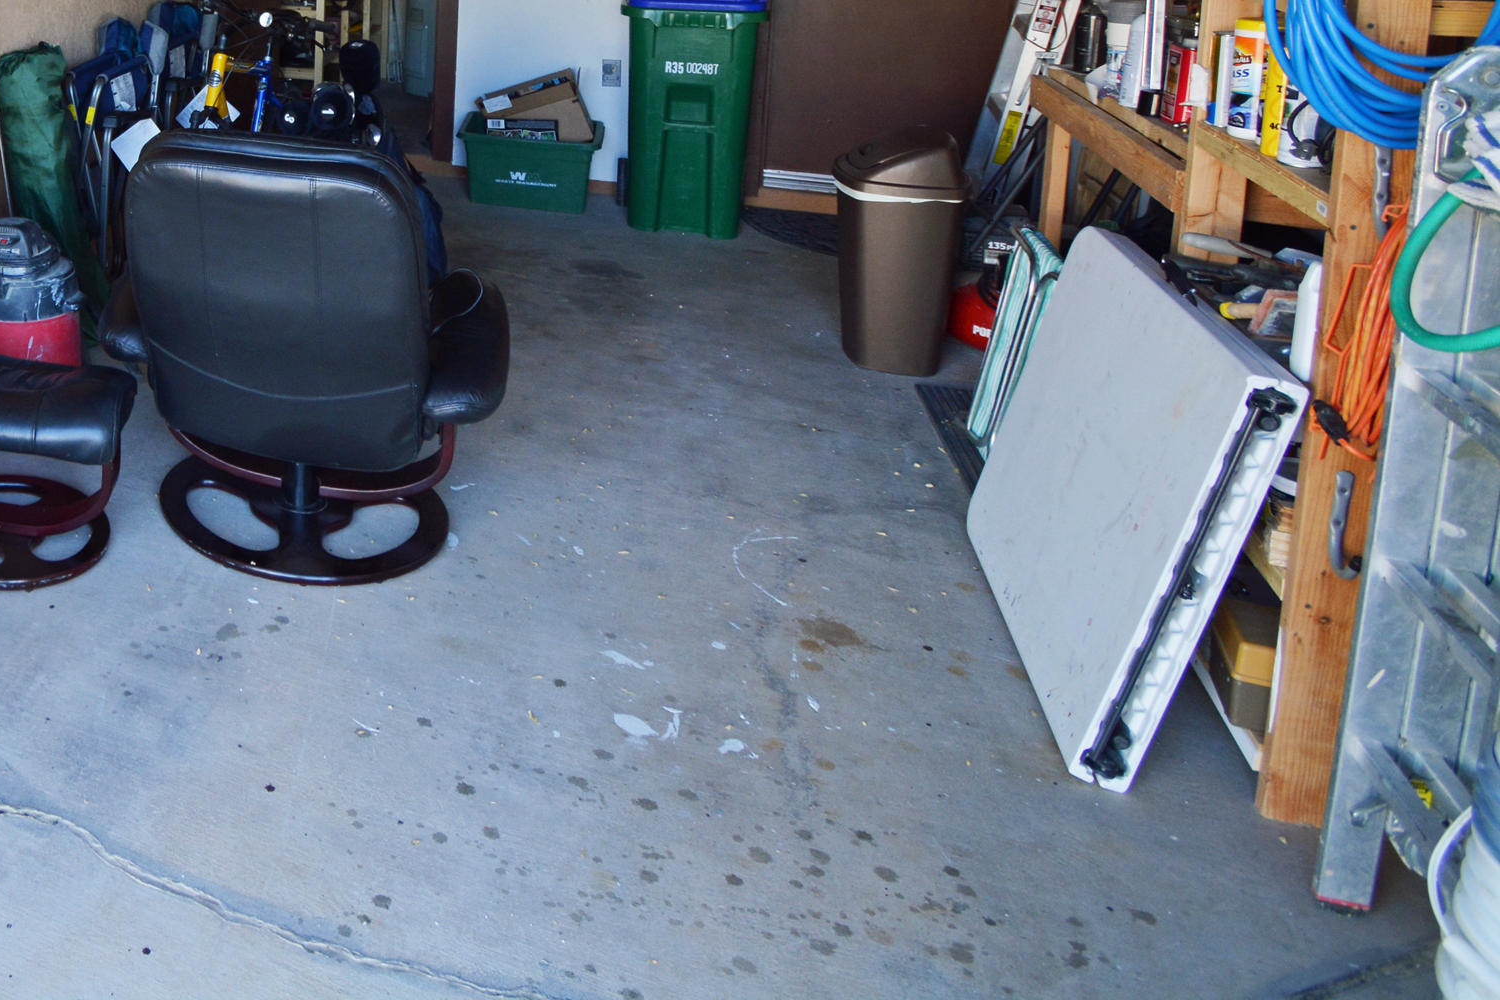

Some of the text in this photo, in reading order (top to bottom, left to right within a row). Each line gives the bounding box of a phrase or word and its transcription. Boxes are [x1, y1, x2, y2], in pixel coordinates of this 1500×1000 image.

[665, 60, 720, 75] R35 002487
[987, 241, 1007, 250] 135
